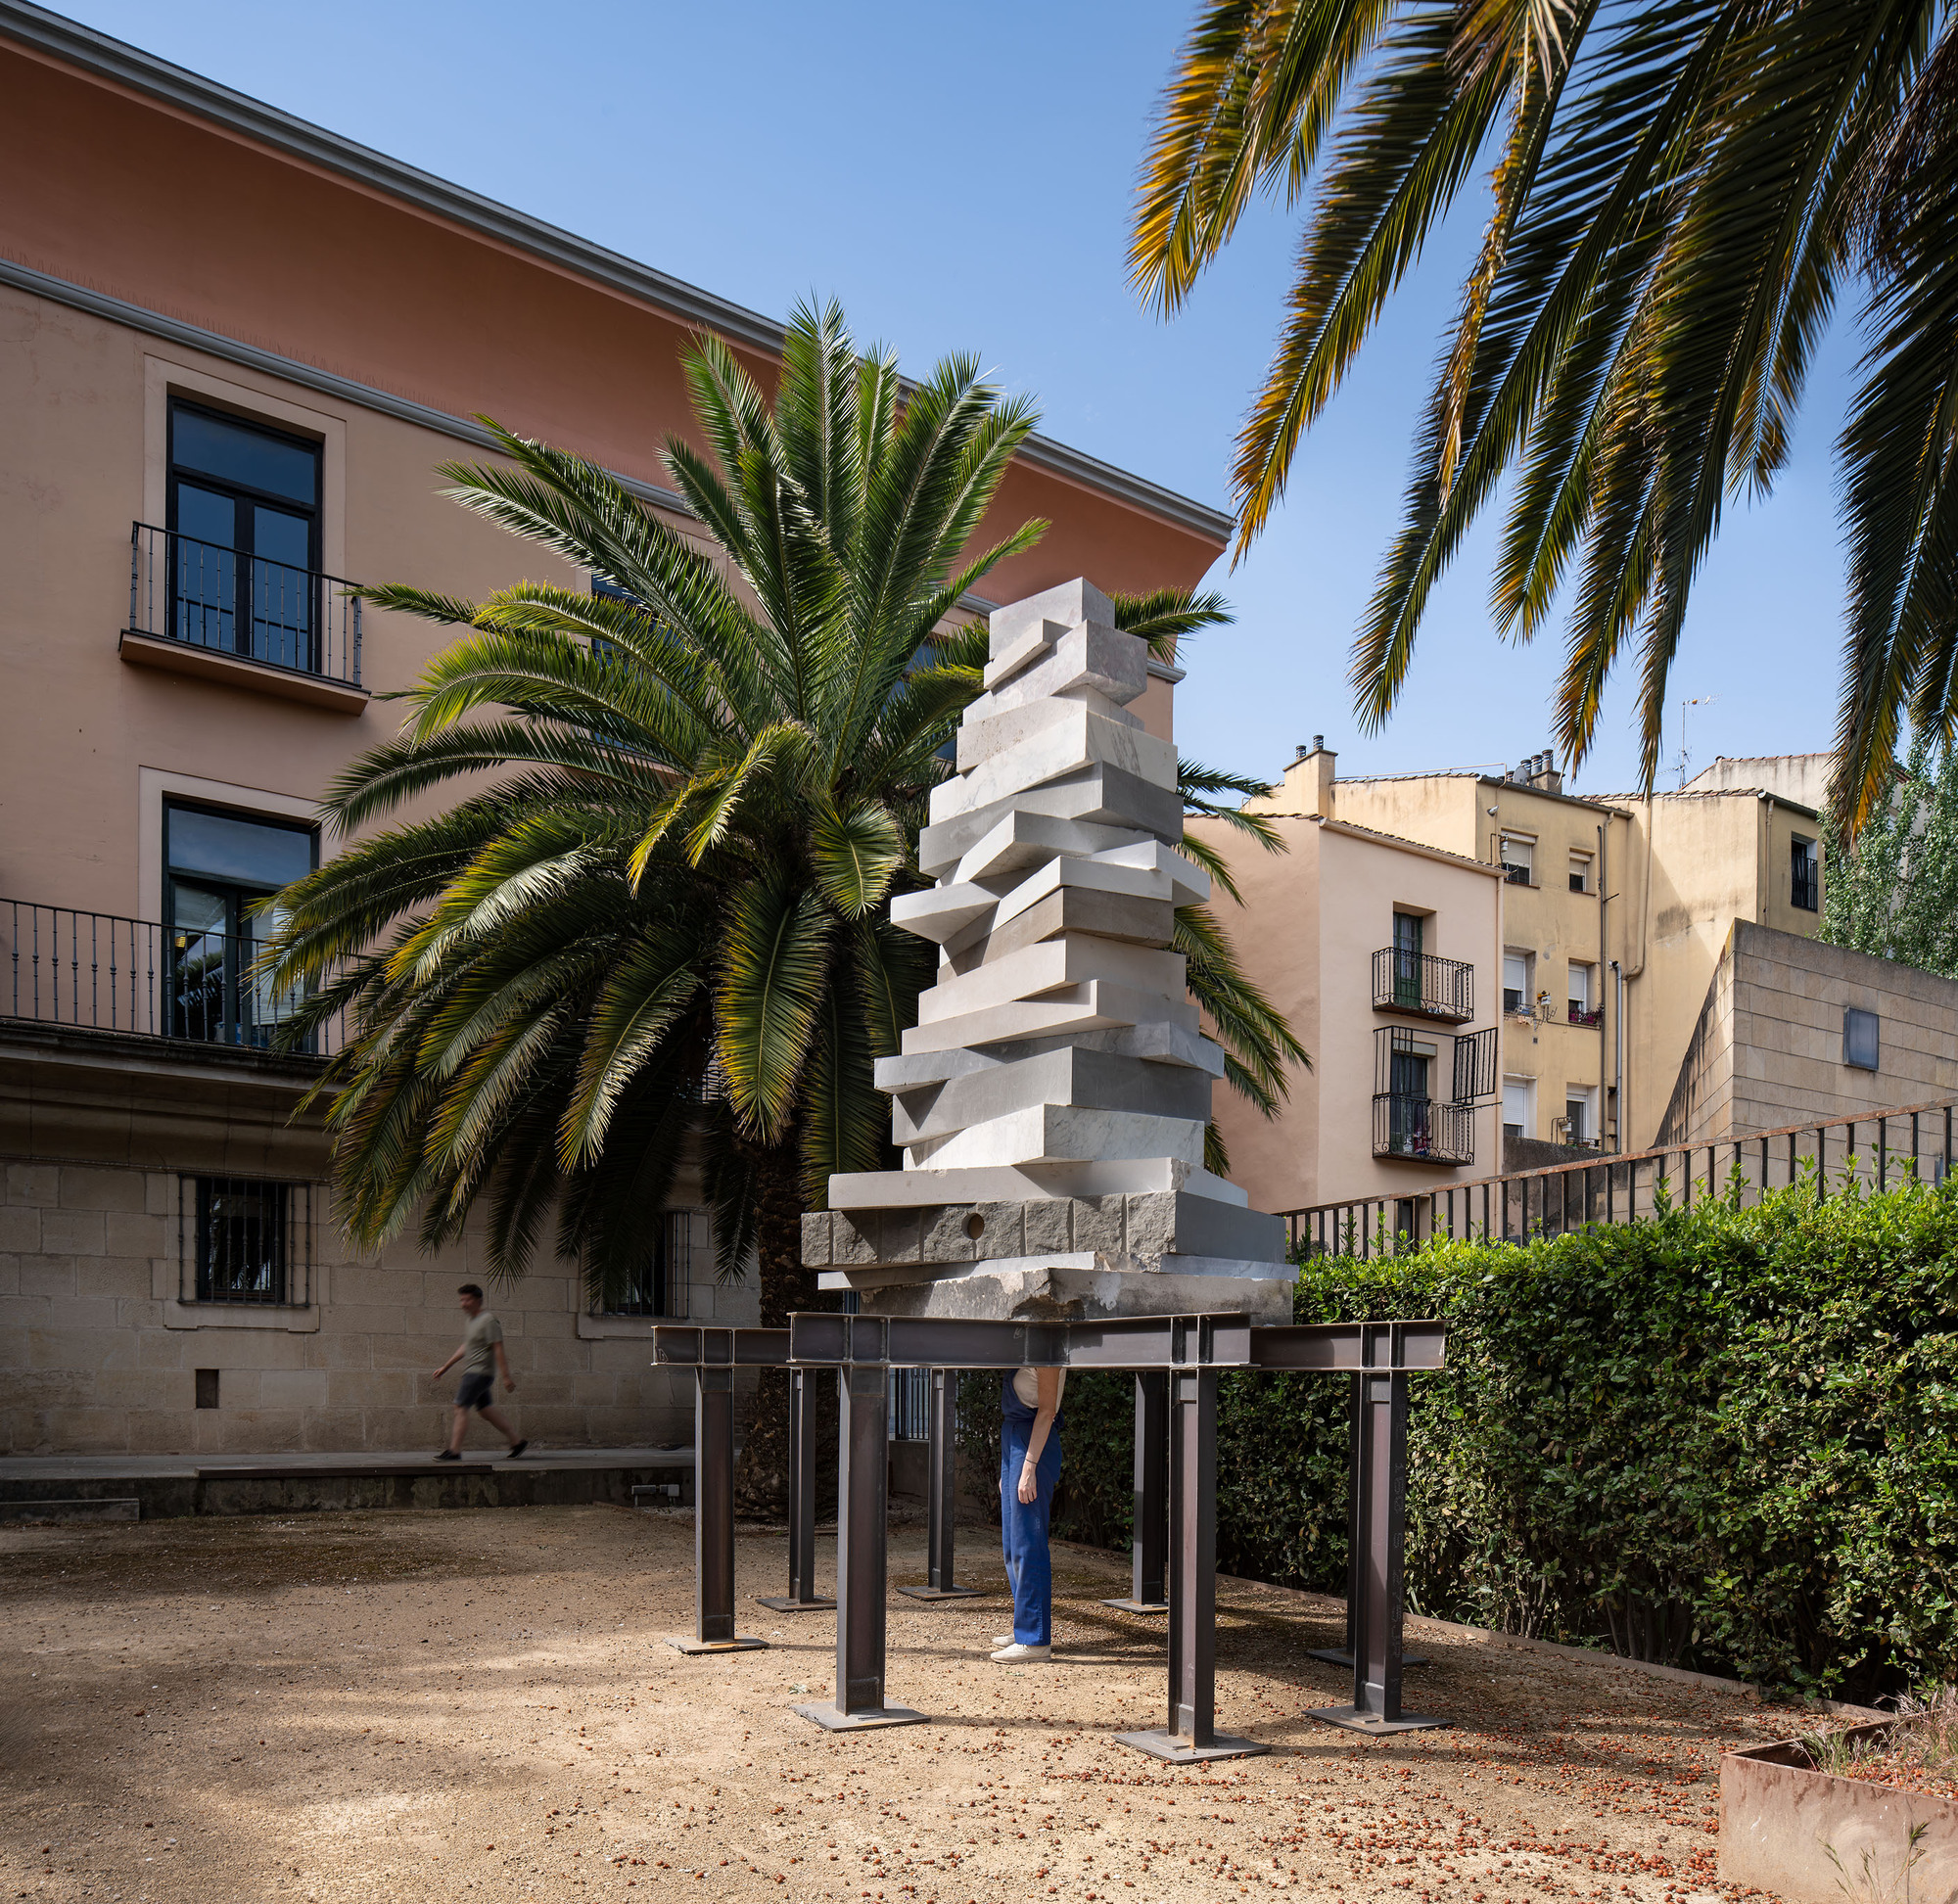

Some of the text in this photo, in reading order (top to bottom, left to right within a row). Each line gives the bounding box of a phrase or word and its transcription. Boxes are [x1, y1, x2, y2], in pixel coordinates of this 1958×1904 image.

[947, 1395, 956, 1428] IPE
[946, 1441, 955, 1474] 160
[945, 1486, 954, 1498] S
[1393, 1463, 1404, 1513] 160
[1393, 1532, 1404, 1549] S
